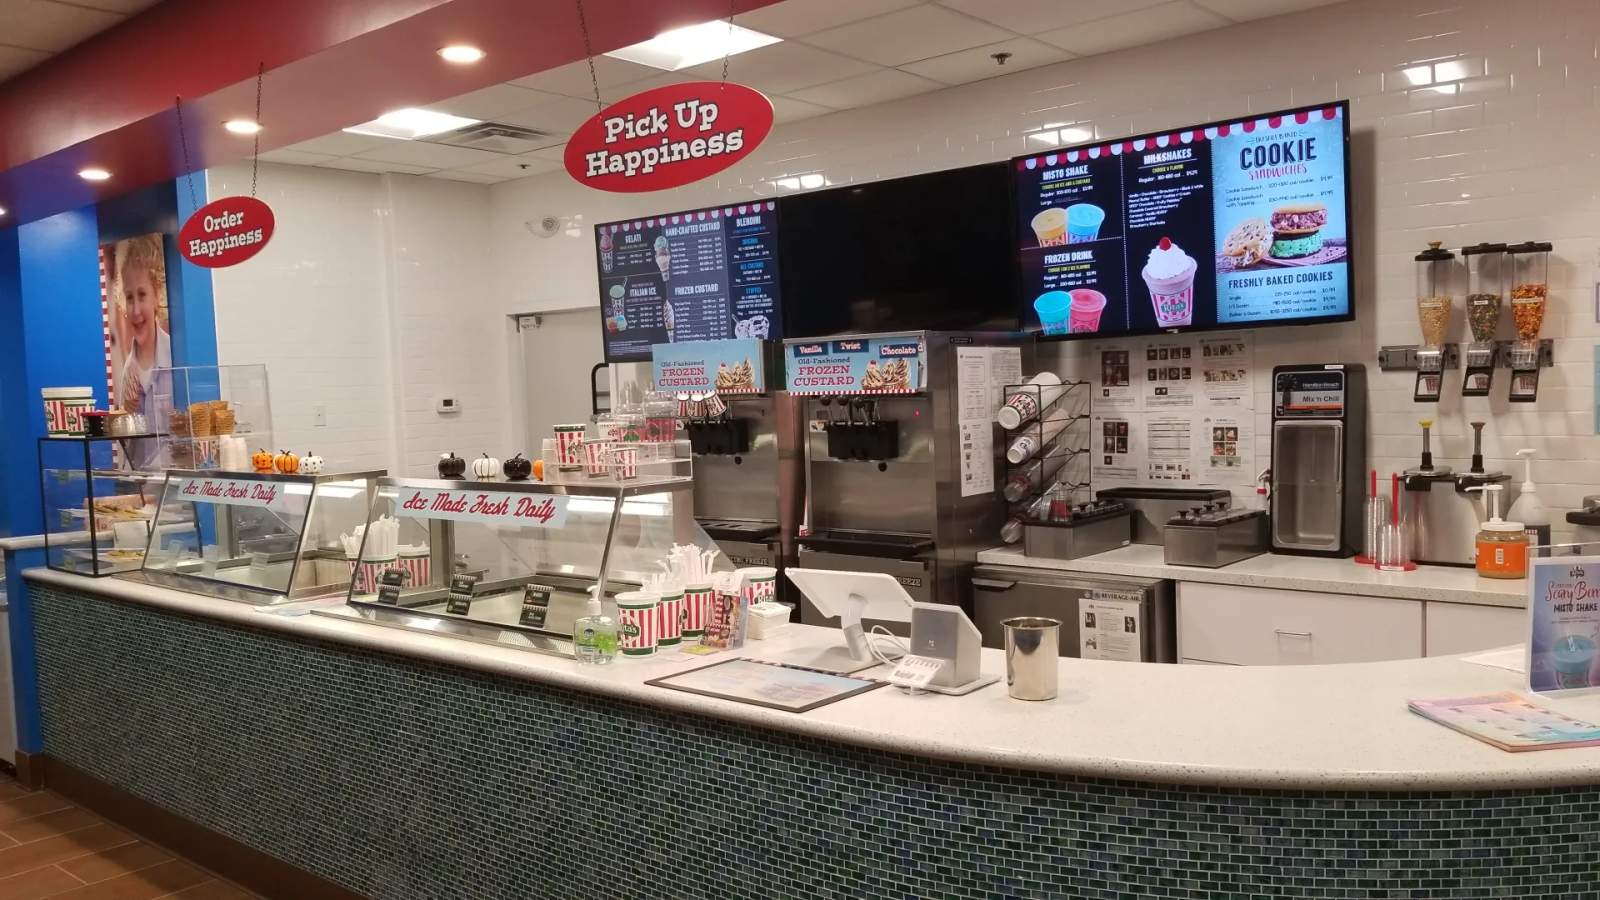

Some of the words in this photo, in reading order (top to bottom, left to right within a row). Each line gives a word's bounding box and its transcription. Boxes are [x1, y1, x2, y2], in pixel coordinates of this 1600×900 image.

[604, 108, 669, 144] Pick
[674, 99, 718, 131] Up
[585, 129, 743, 177] Happiness
[1143, 148, 1192, 165] MILKSHAKES
[1240, 137, 1317, 170] COOKIE
[1042, 168, 1064, 180] MISTO
[1065, 165, 1089, 177] SHAKE
[204, 211, 244, 232] Order
[189, 228, 262, 257] Happiness
[1044, 253, 1070, 264] FROZEN
[1072, 250, 1093, 261] DRINK
[1228, 277, 1264, 289] FRESHLY
[1266, 274, 1294, 286] BAKED
[1296, 271, 1333, 283] COOKIES
[674, 286, 694, 296] FROZEN
[695, 283, 719, 294] CUSTARD
[799, 345, 823, 354] Vanilla
[840, 342, 862, 350] Twist
[881, 346, 916, 356] Chocolate
[660, 360, 704, 368] Old-Fashioned
[798, 356, 850, 365] Old-Fashioned
[662, 367, 705, 377] FROZEN
[798, 366, 850, 376] FROZEN
[659, 377, 709, 387] CUSTARD
[794, 376, 855, 387] CUSTARD
[183, 480, 199, 495] Ice
[200, 481, 222, 497] Made
[224, 482, 247, 499] Fresh
[251, 484, 277, 504] Daily
[403, 492, 428, 510] Ice
[430, 492, 466, 513] Made
[469, 494, 509, 516] Fresh
[513, 496, 556, 524] Daily
[1545, 580, 1573, 604] Scary
[1574, 581, 1600, 600] Berr
[1554, 604, 1573, 613] MISTO
[1576, 602, 1598, 612] SHAKE
